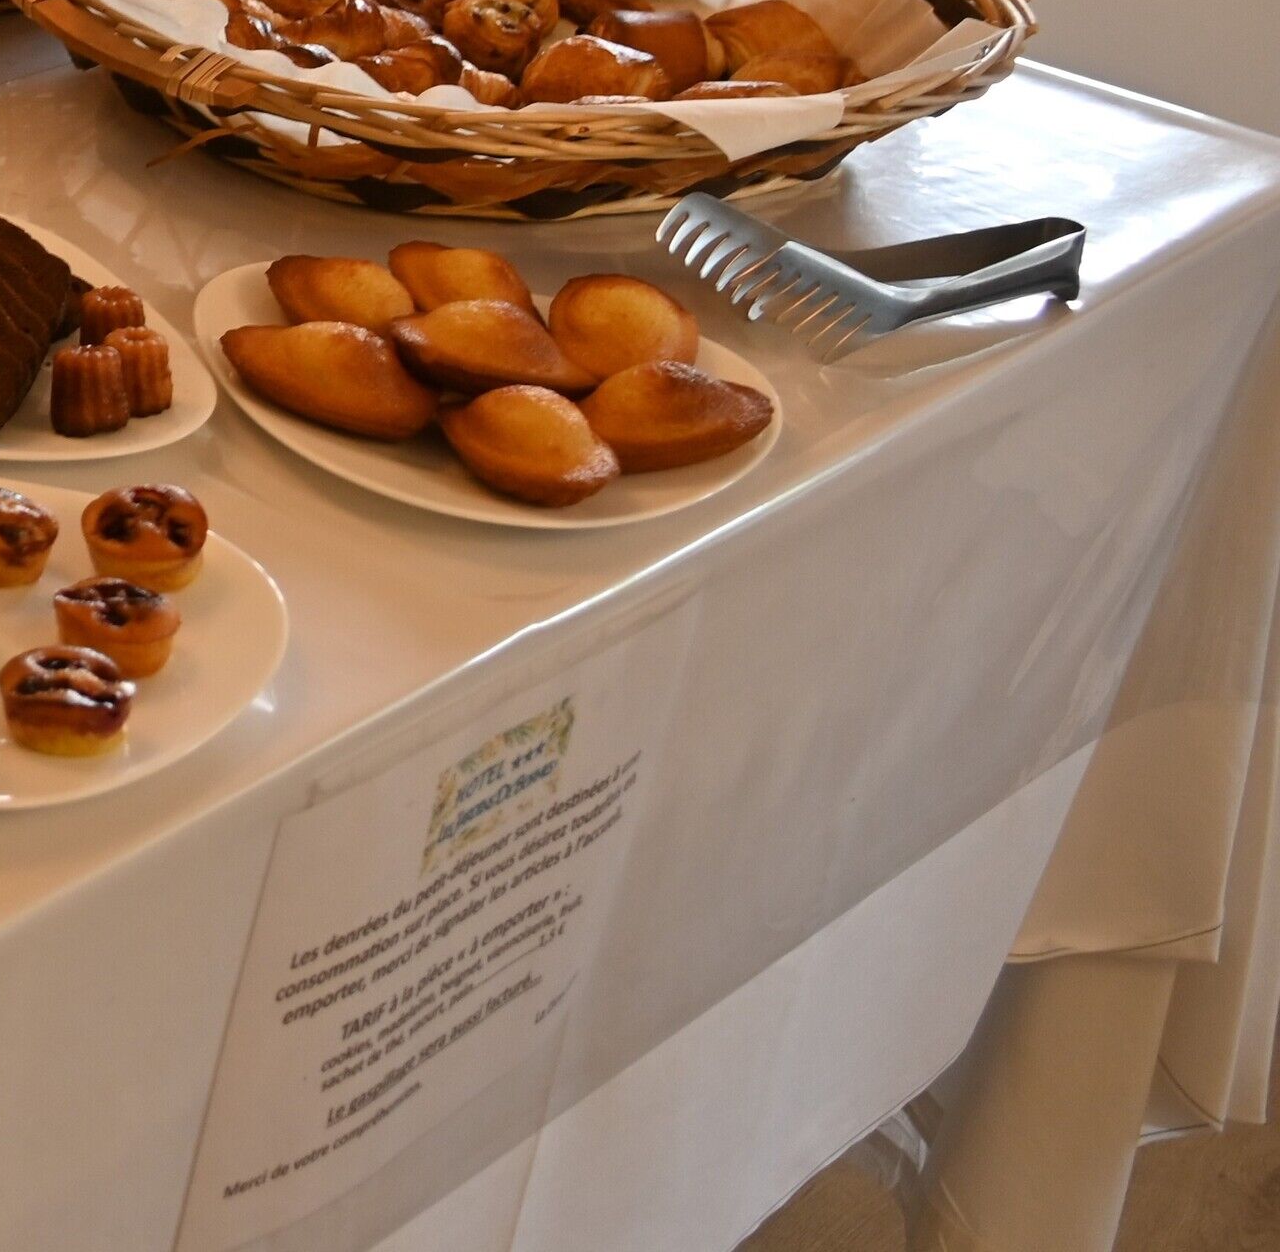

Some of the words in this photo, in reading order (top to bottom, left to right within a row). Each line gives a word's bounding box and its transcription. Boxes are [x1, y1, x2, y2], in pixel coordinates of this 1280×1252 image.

[275, 932, 400, 1002] consommation
[403, 913, 426, 940] sur
[484, 853, 517, 882] vous
[290, 947, 319, 970] Les
[322, 911, 390, 956] denrées
[392, 899, 413, 920] du
[513, 811, 545, 841] sont
[545, 775, 612, 821] destinées
[342, 1000, 387, 1041] TARIF
[481, 895, 550, 947] emporter
[222, 1168, 268, 1199] Merci
[270, 1162, 290, 1181] de
[293, 1144, 330, 1171] votre
